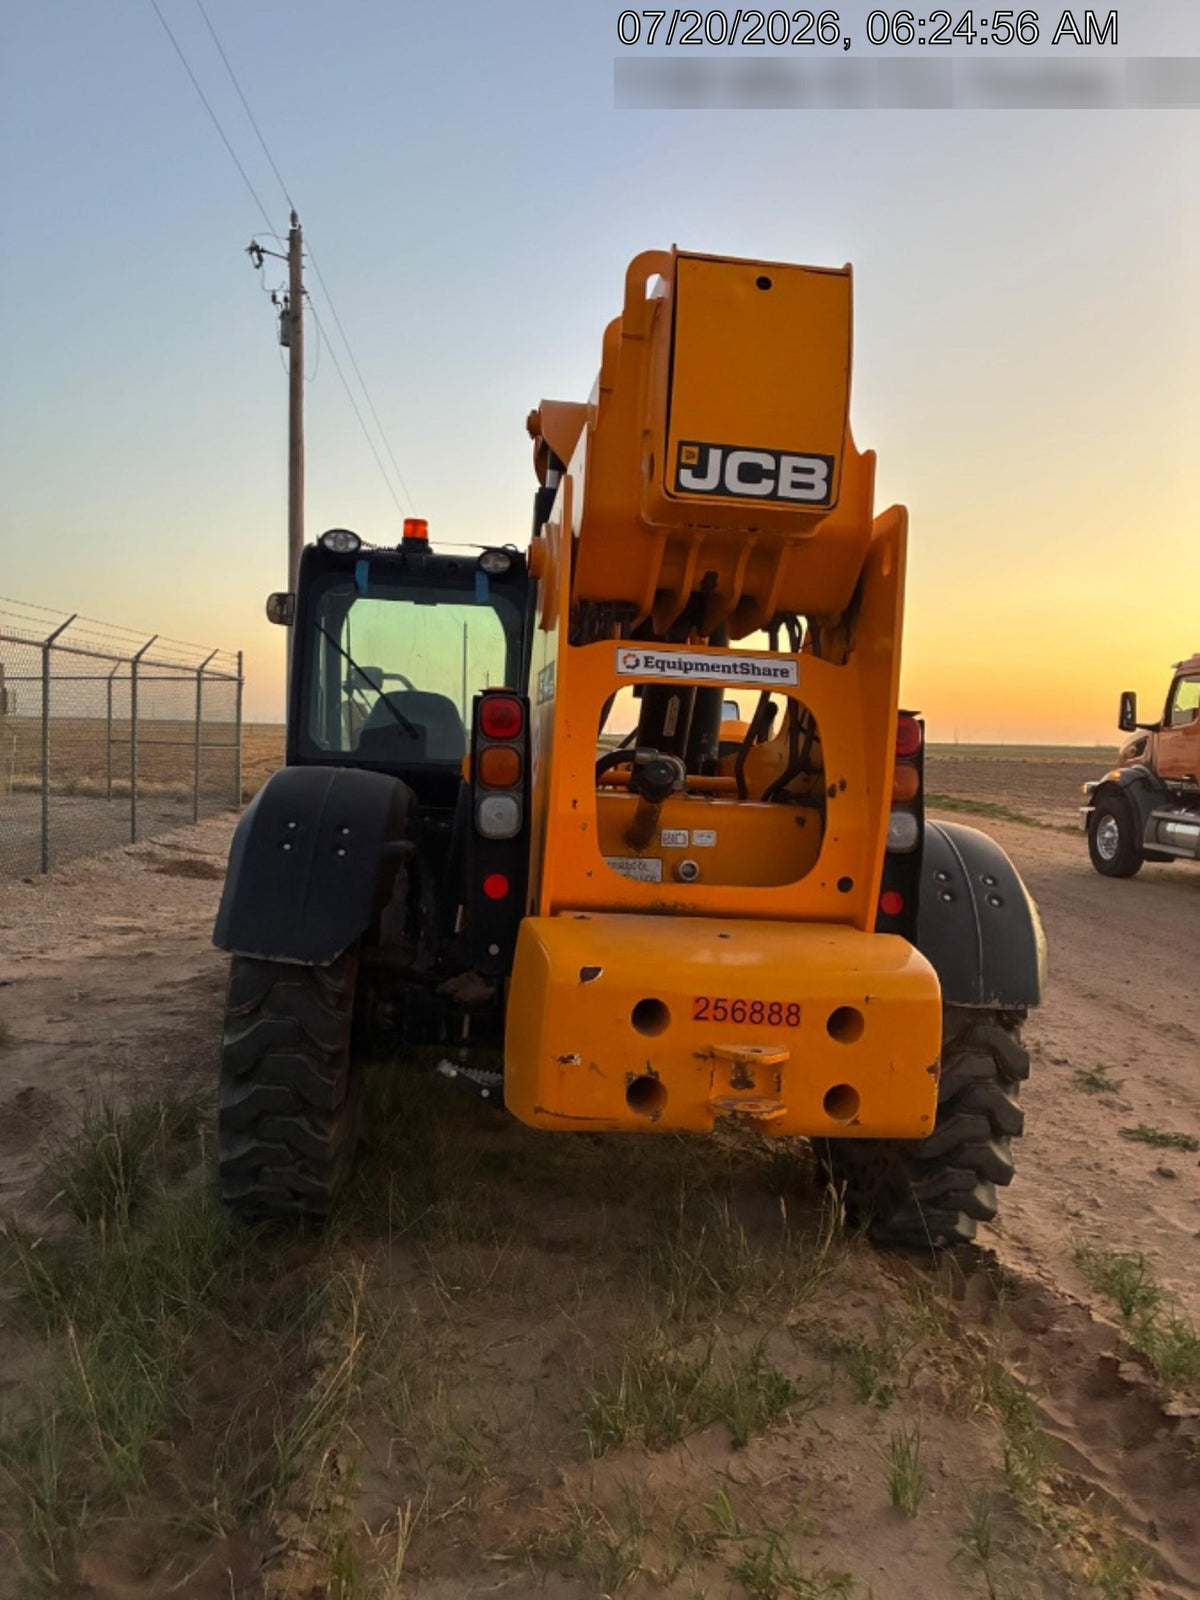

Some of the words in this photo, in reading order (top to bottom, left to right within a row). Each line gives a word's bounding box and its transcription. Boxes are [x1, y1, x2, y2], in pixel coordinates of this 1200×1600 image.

[679, 448, 829, 500] JCB
[643, 655, 790, 678] EquipmentShare
[693, 996, 801, 1027] 256888
